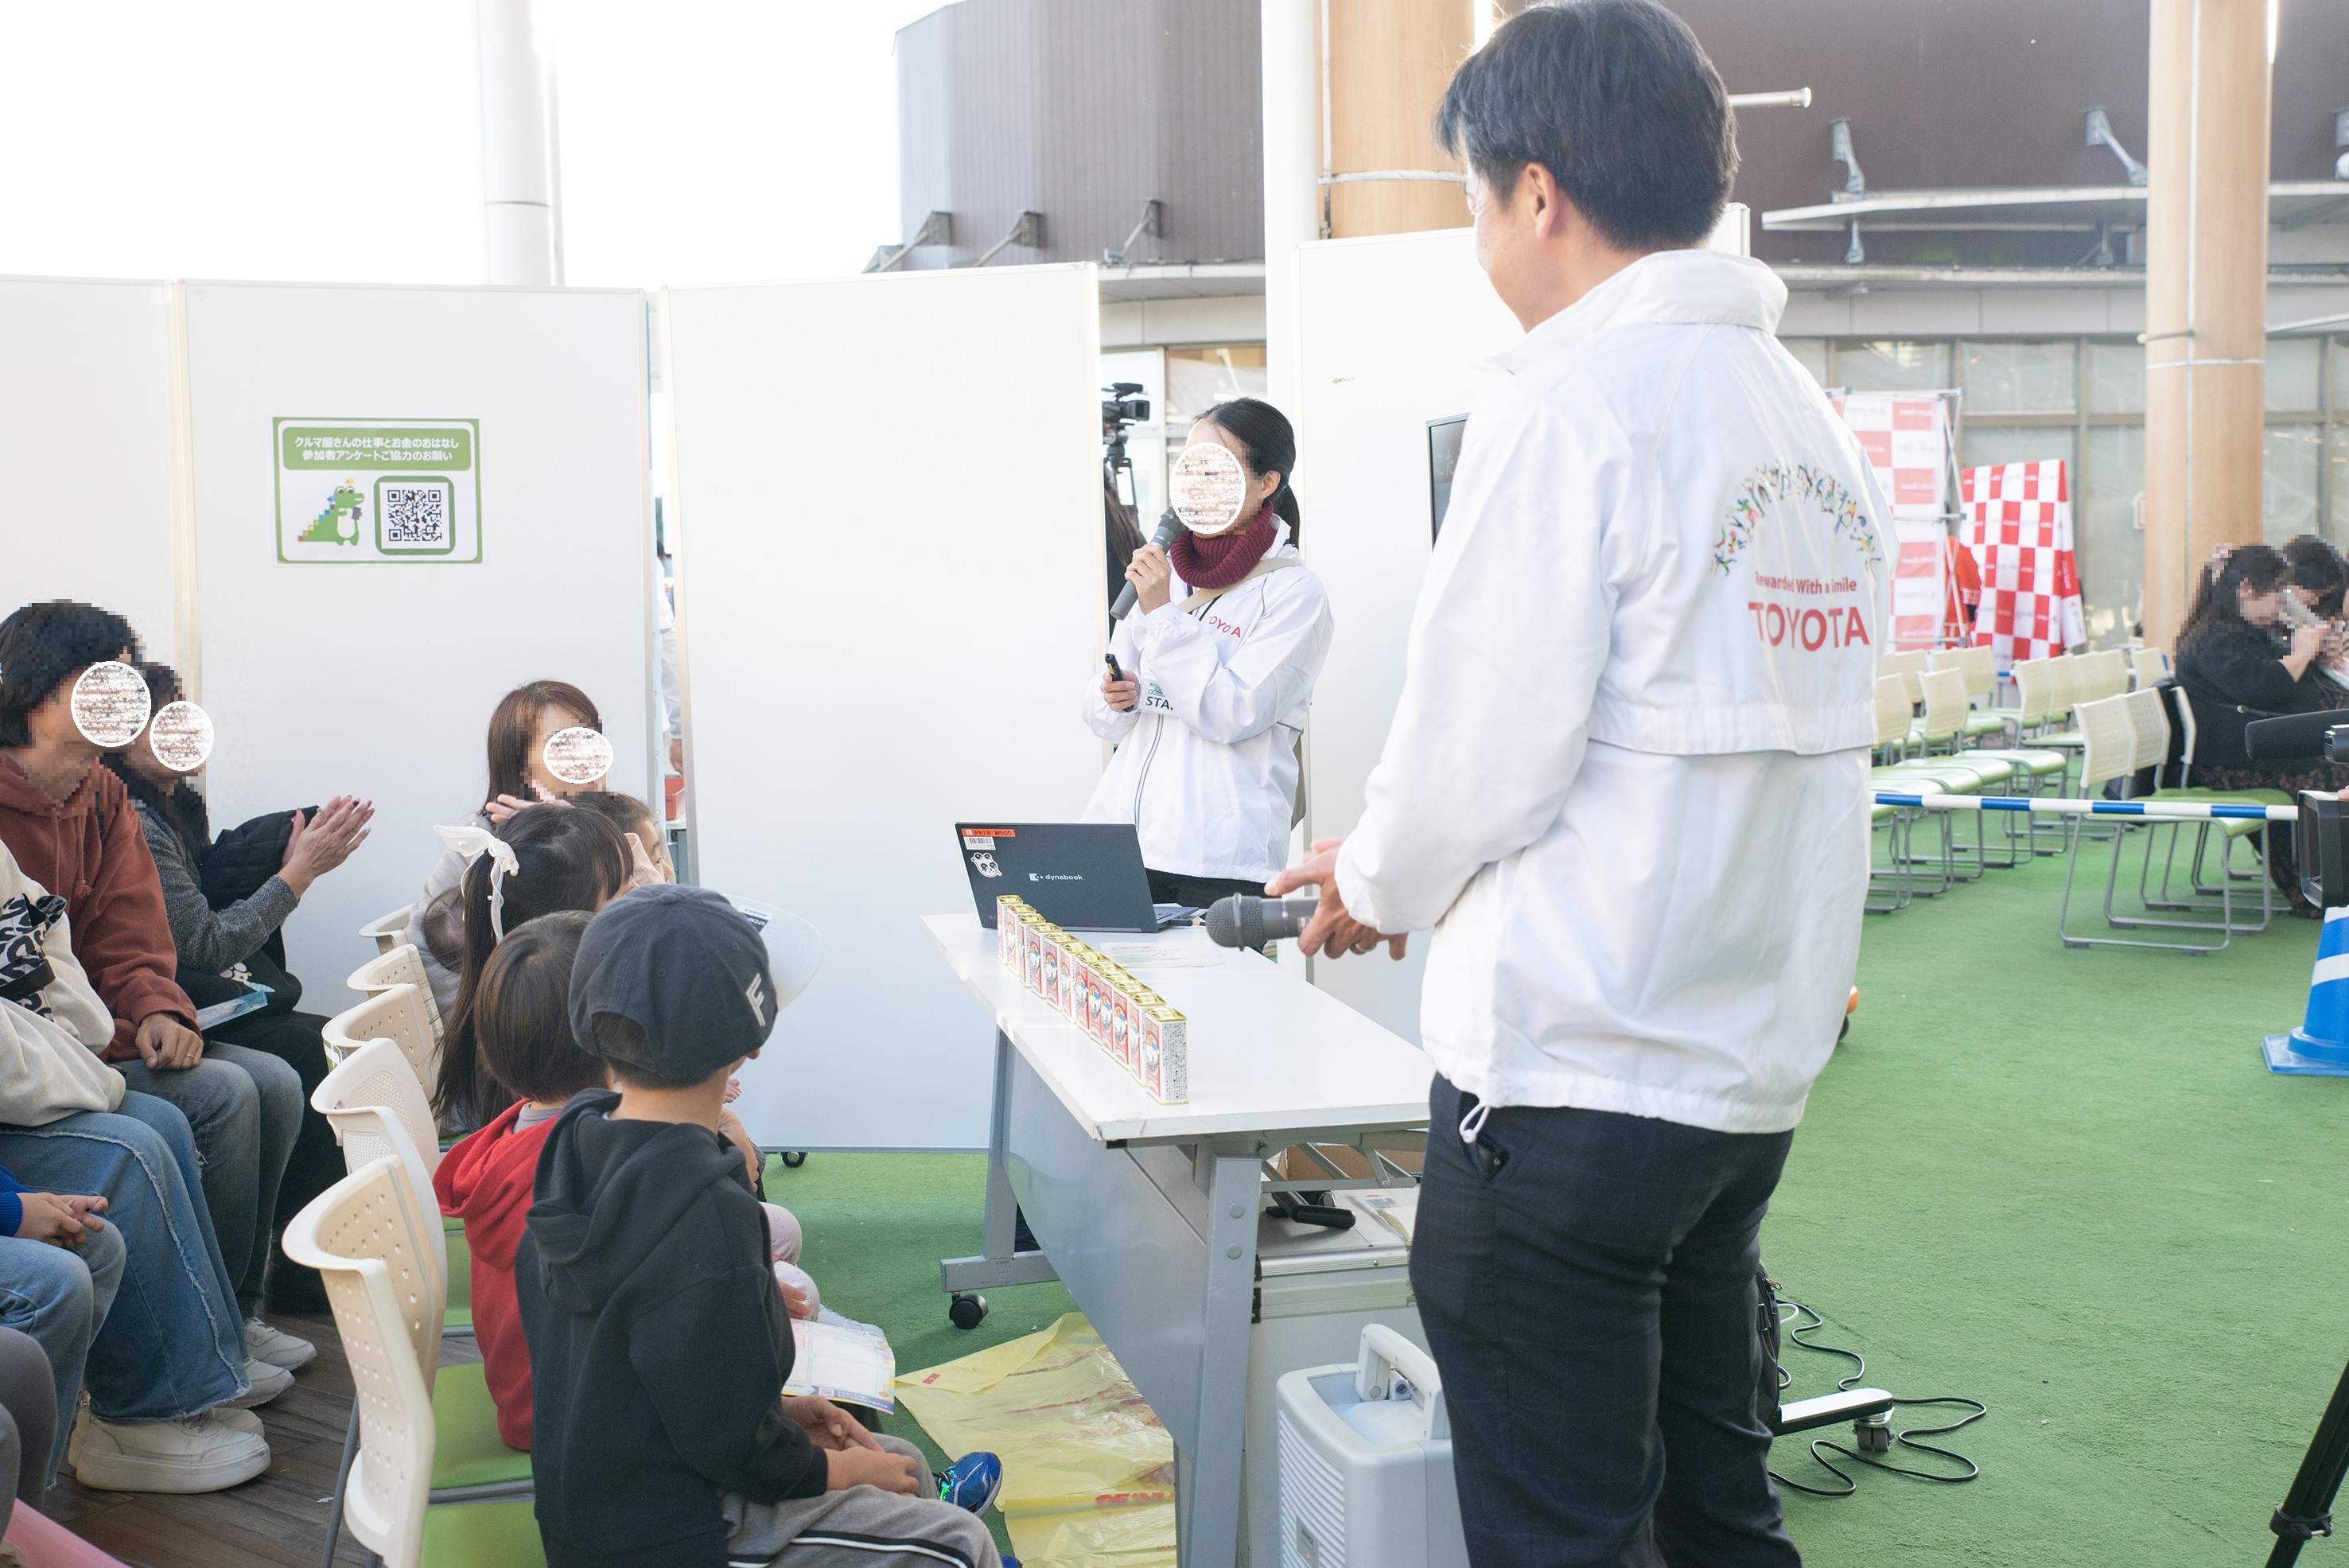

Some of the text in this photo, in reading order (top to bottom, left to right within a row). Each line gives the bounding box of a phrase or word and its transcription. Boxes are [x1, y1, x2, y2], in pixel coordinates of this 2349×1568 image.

[294, 437, 459, 449] クルマ屋さんの仕事とお金のおはなし
[301, 449, 453, 461] 参加者アンケートご協力のお願い
[1755, 571, 1795, 593] Rewarded
[1796, 579, 1822, 594] With
[1824, 583, 1830, 593] a
[1208, 616, 1241, 639] OYOA
[1748, 601, 1870, 652] TOYOTA
[1145, 696, 1173, 710] STA
[745, 973, 766, 1027] F
